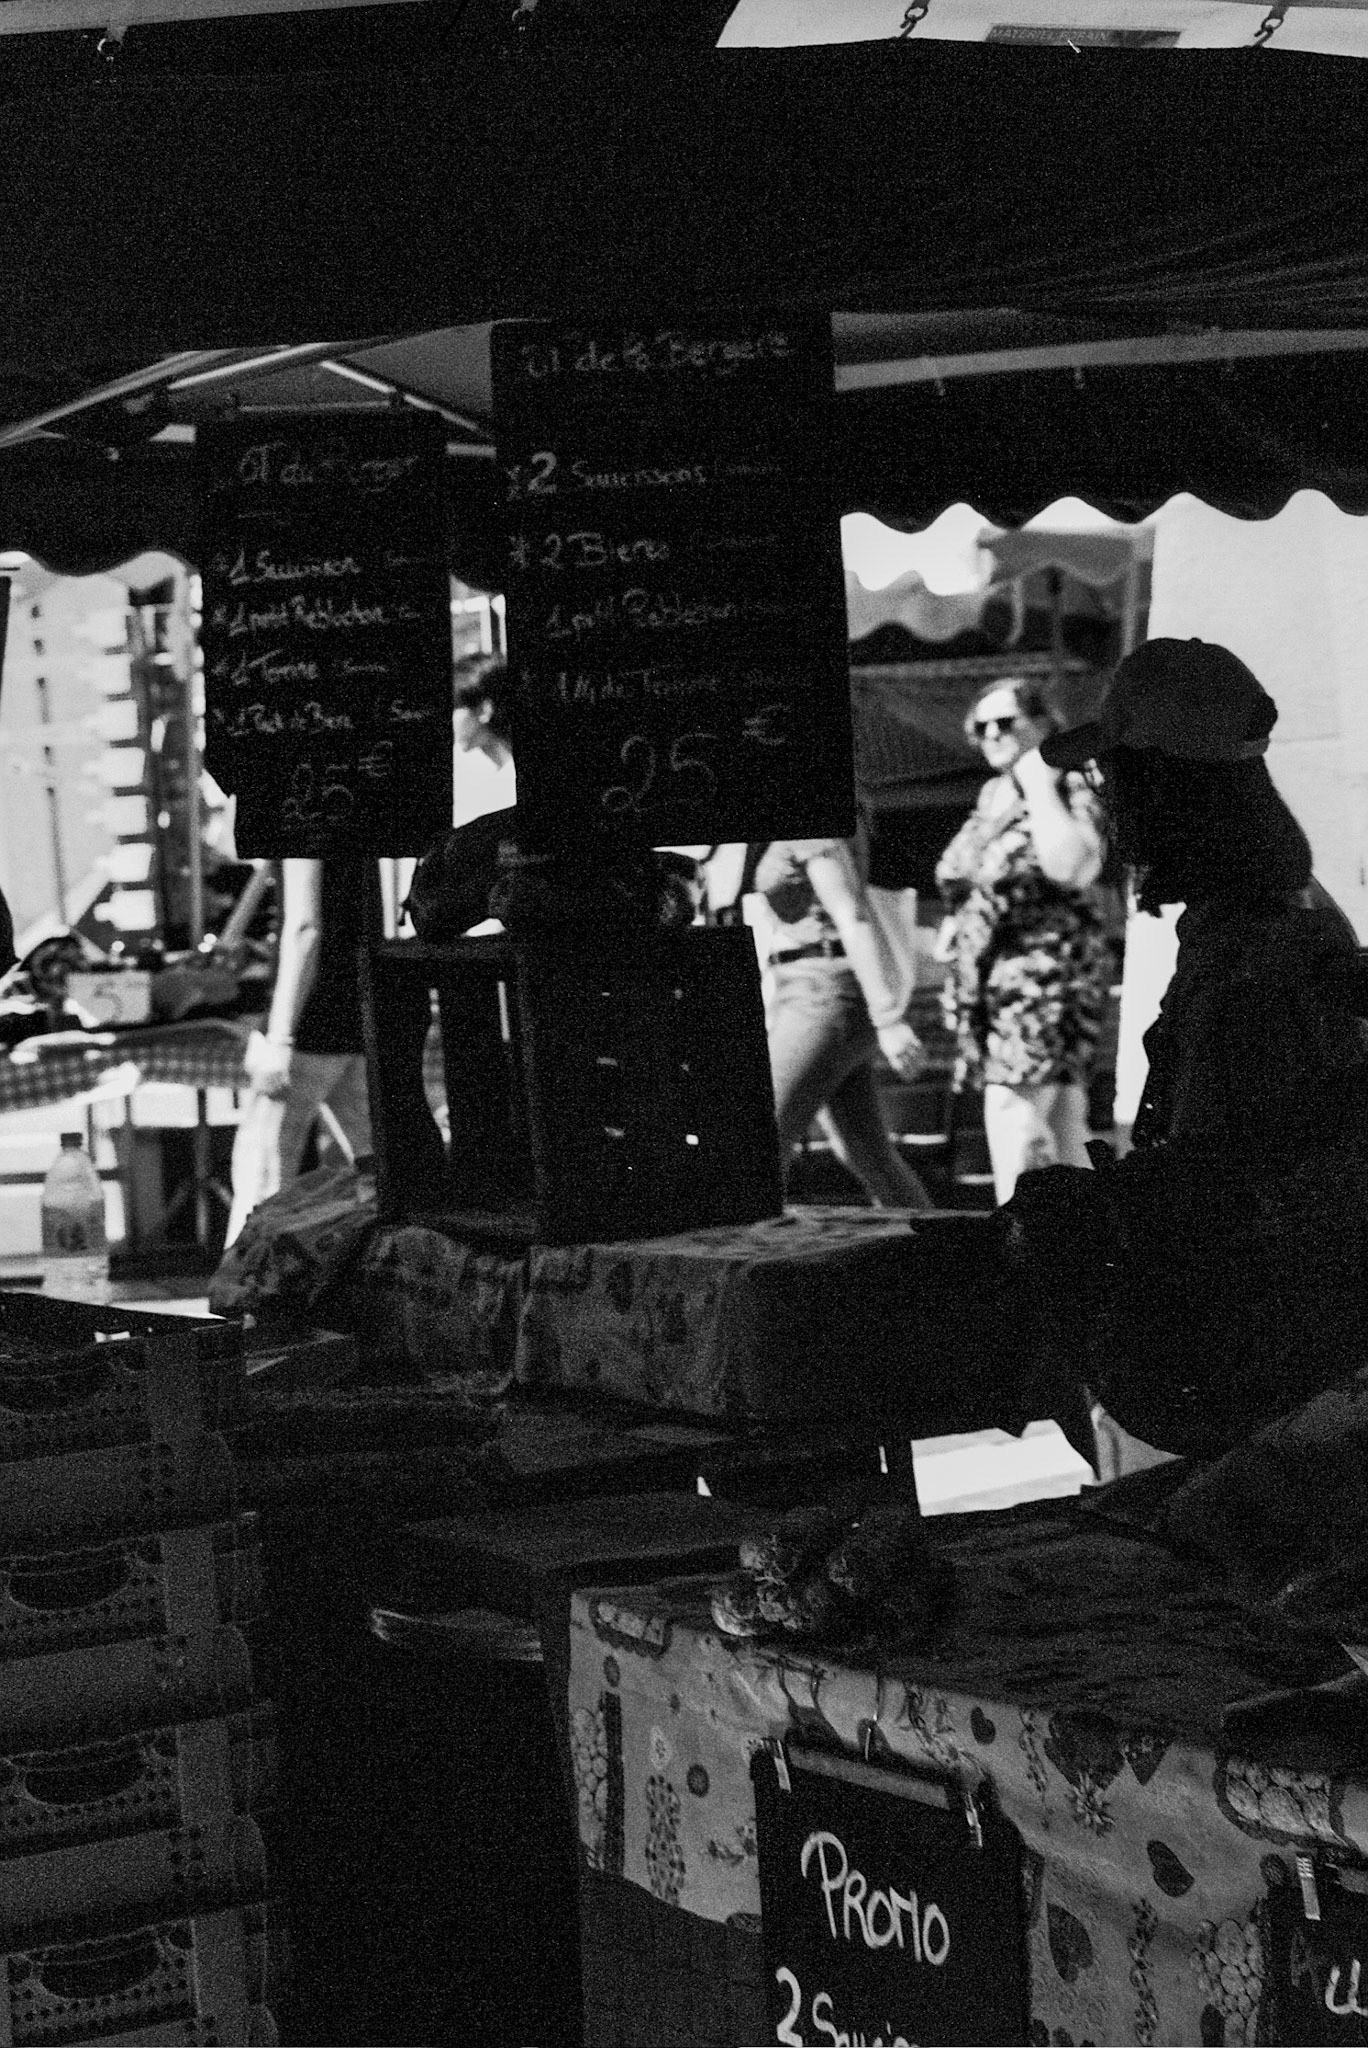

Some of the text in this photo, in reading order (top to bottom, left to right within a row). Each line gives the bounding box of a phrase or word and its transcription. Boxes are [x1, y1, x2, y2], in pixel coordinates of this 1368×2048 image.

[527, 450, 557, 495] 2
[228, 548, 251, 586] 1
[540, 532, 564, 570] 2
[356, 740, 394, 779] €
[601, 703, 791, 812] 25 €
[800, 1830, 950, 1966] PROMO
